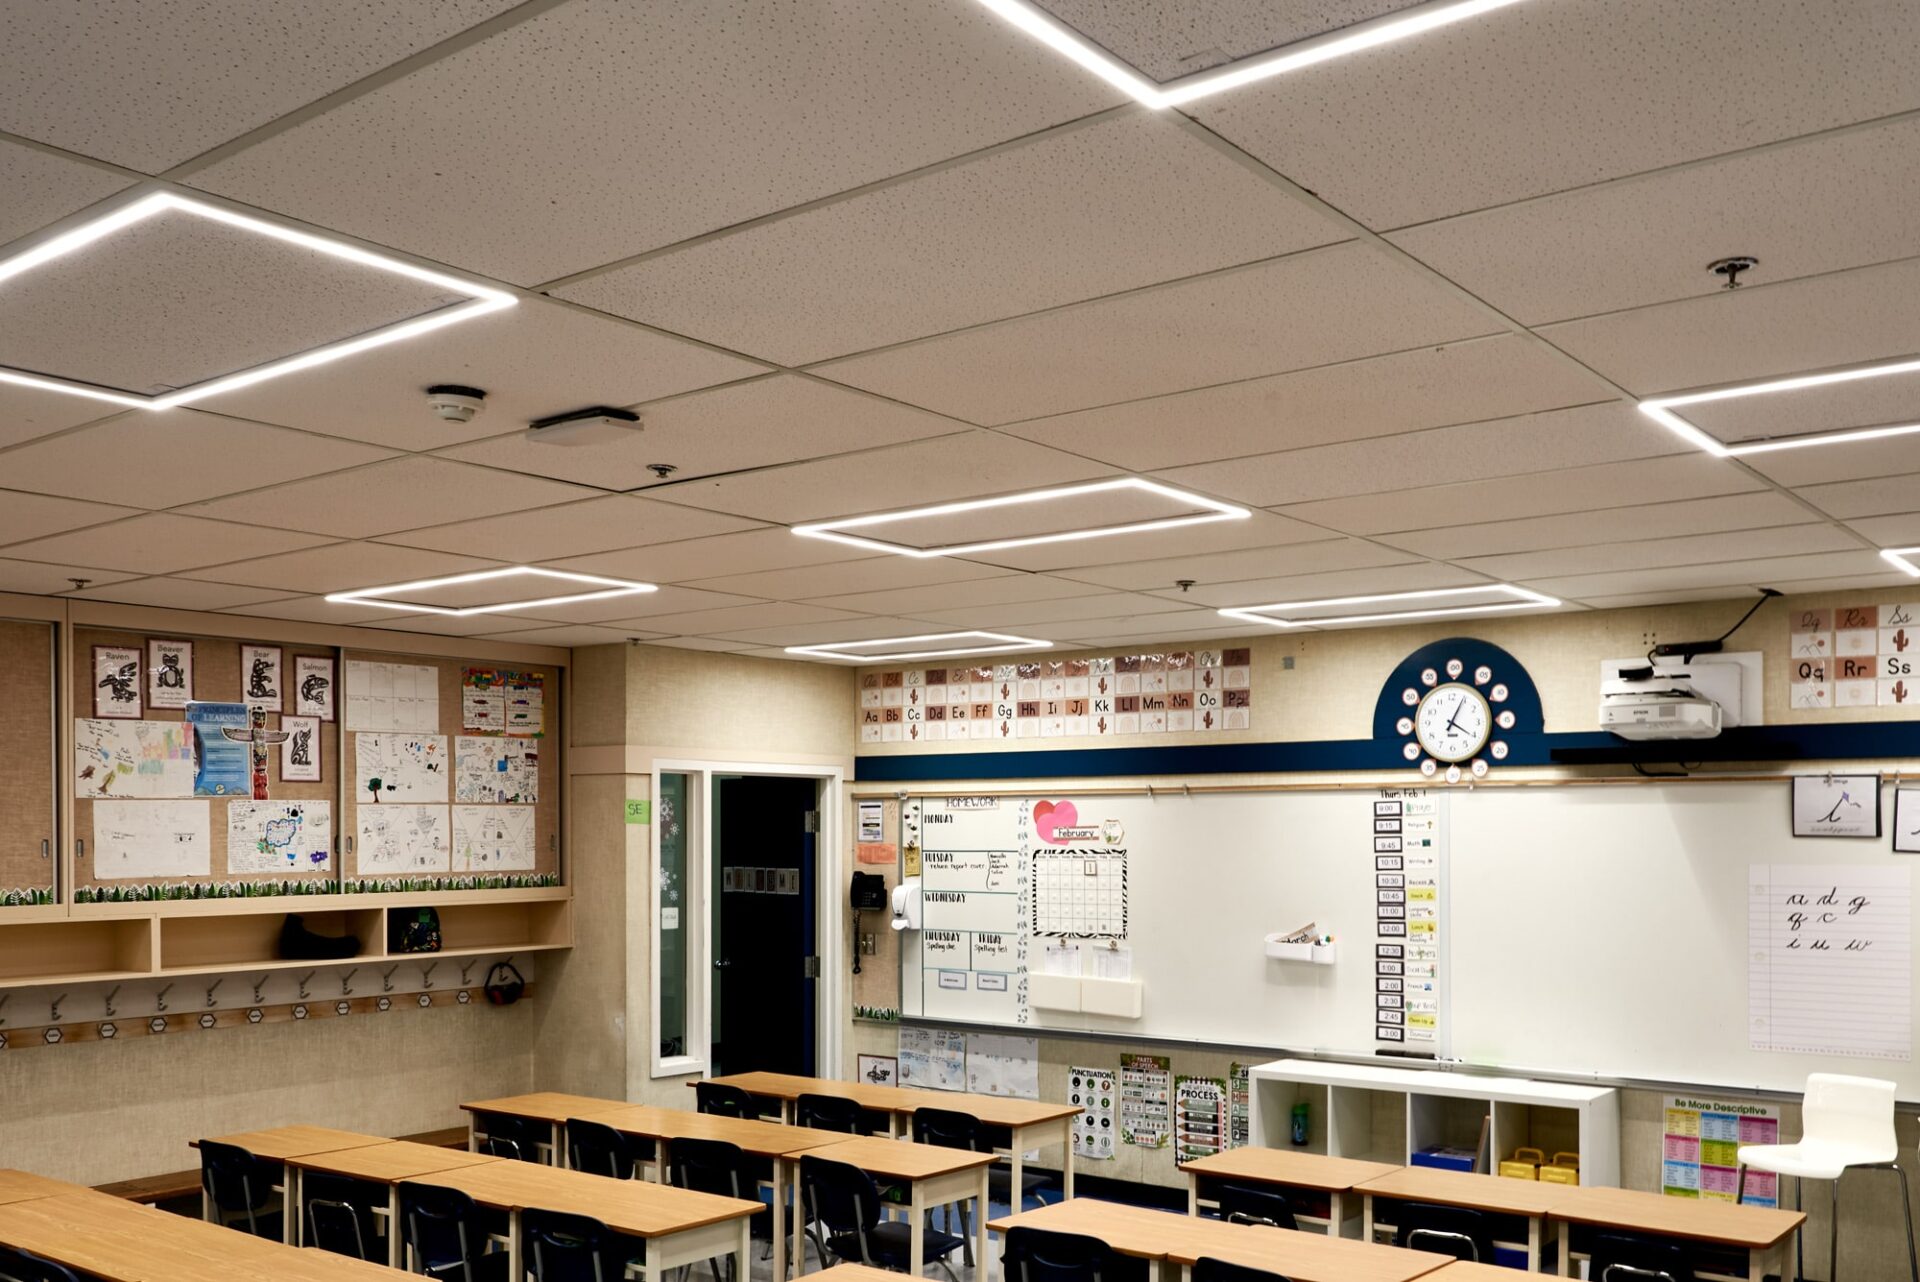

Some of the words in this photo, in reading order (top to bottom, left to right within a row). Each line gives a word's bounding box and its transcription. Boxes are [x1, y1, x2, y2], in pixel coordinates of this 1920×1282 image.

[158, 644, 184, 653] Beaver
[106, 652, 130, 661] Raven
[254, 650, 270, 658] Bear
[302, 663, 328, 672] Salmon
[1799, 662, 1824, 682] Qq
[1844, 660, 1867, 677] Rr
[1888, 658, 1911, 675] Ss
[865, 711, 878, 722] Aa
[886, 710, 899, 721] Bb
[907, 708, 920, 720] Cc
[929, 707, 943, 719] Dd
[952, 706, 965, 718] Ee
[976, 705, 988, 717] Ff
[998, 705, 1012, 720] Gg
[1022, 704, 1035, 716] Hh
[1049, 703, 1057, 714] Ii
[1072, 701, 1083, 715] Jj
[1095, 699, 1109, 712] Kk
[1143, 697, 1164, 709] Mm
[1172, 696, 1189, 707] Nn
[1200, 694, 1216, 706] Oo
[1228, 695, 1244, 709] Pp
[203, 714, 246, 722] LEARNING
[1404, 789, 1418, 798] Feb
[628, 803, 642, 815] SE
[924, 814, 953, 824] MONDAY
[1058, 828, 1094, 838] February
[925, 853, 953, 862] TUESDAY
[925, 893, 966, 903] WEDNESDAY
[1787, 894, 1808, 906] a
[1816, 886, 1838, 906] d
[1848, 896, 1870, 915] g
[1817, 912, 1837, 923] c
[925, 932, 960, 942] THURSDAY
[979, 934, 1002, 944] FRIDAY
[1810, 938, 1830, 950] u
[1845, 938, 1872, 951] w
[1072, 1068, 1112, 1079] PUNCTUATION
[1181, 1089, 1218, 1100] PROCESS
[1688, 1100, 1711, 1110] More
[1714, 1103, 1767, 1115] Descriptive
